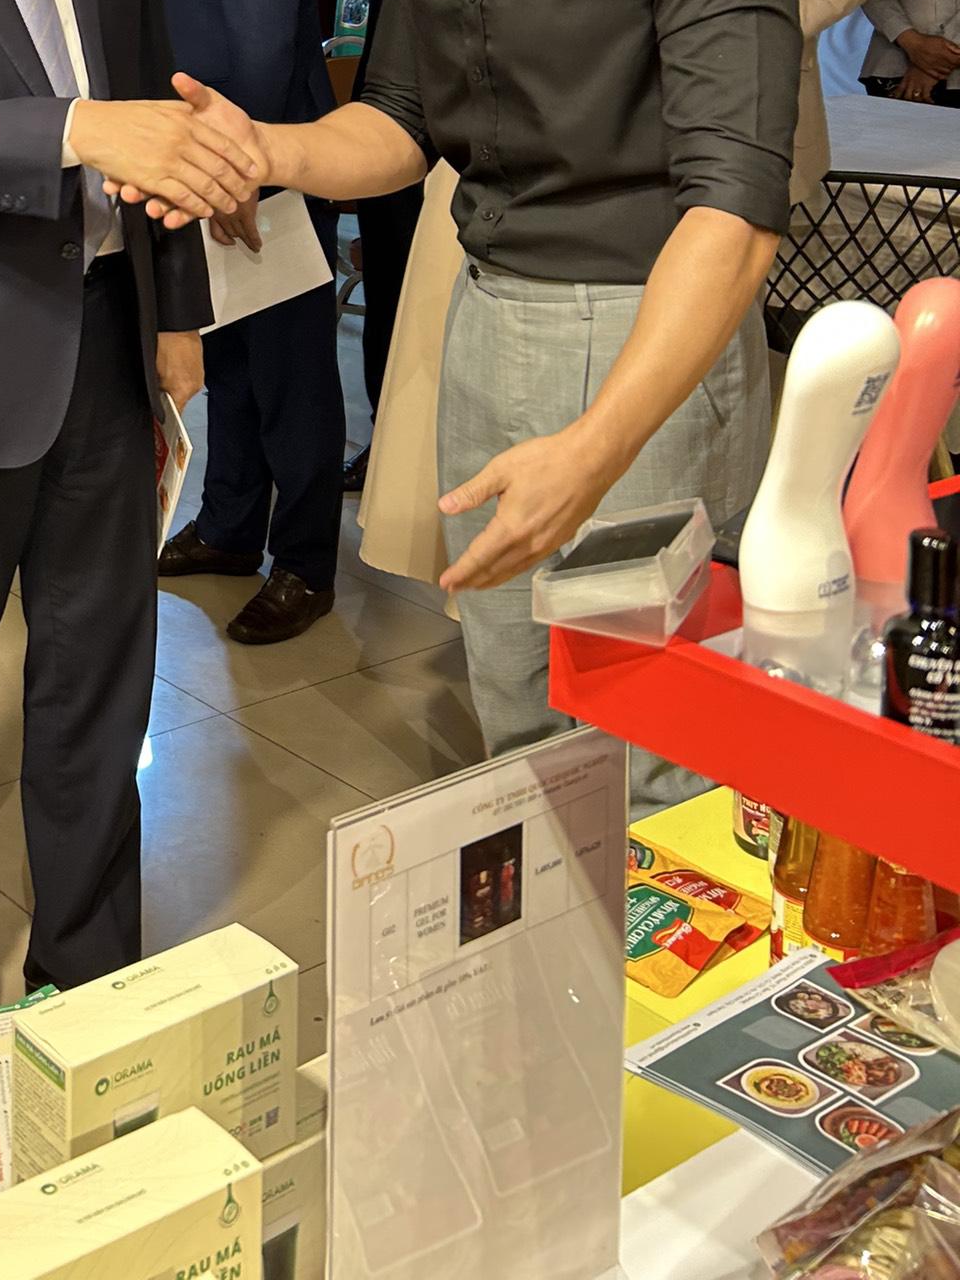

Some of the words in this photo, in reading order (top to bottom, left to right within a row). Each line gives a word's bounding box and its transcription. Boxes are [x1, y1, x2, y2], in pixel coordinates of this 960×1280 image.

[226, 1040, 257, 1066] RAU
[259, 1024, 282, 1049] MÁ
[114, 1058, 153, 1082] ORAMA
[203, 1066, 247, 1097] UỐNG
[248, 1048, 282, 1075] LIỀN
[215, 1235, 242, 1266] MÁ
